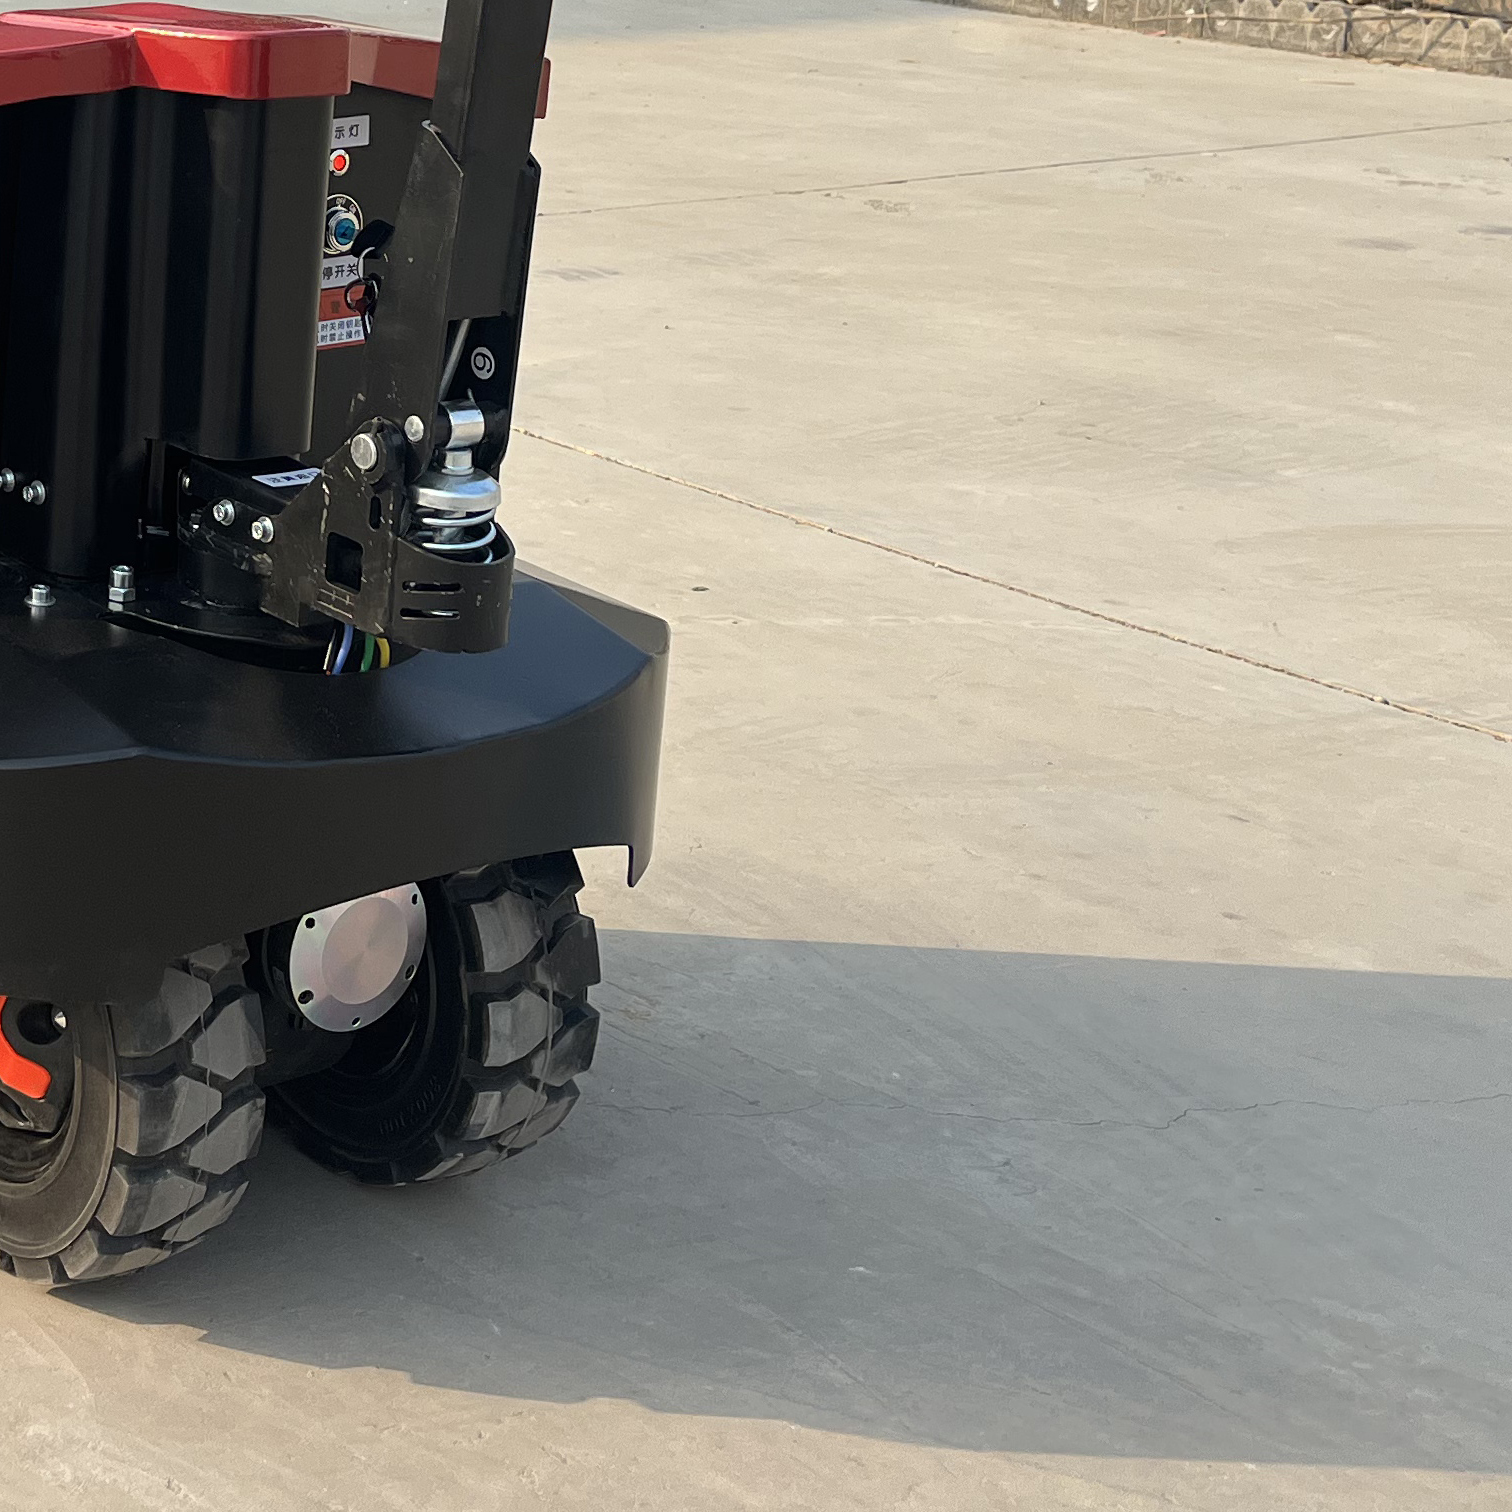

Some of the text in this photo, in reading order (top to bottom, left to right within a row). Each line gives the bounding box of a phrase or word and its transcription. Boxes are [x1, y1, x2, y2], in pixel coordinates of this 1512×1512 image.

[318, 318, 362, 333] 时关闭钥匙
[318, 329, 362, 344] 时禁止操作
